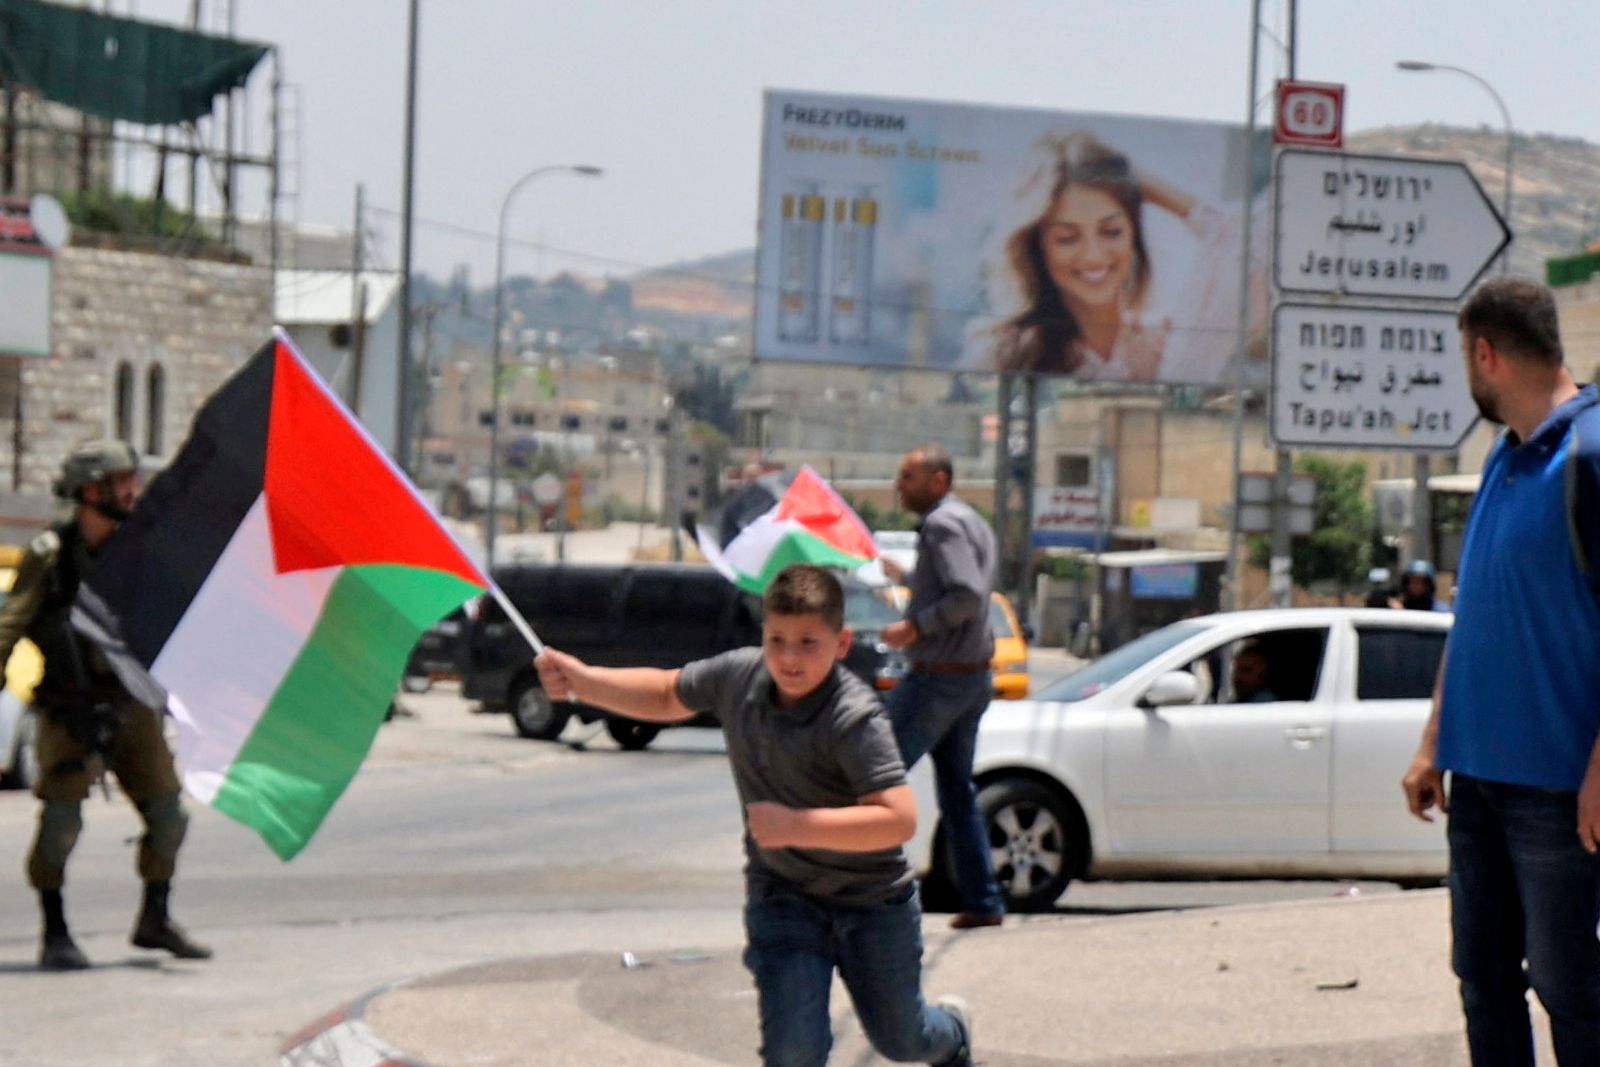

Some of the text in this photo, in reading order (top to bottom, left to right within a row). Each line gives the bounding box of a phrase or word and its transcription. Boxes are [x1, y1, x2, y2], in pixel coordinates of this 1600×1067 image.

[1292, 102, 1328, 127] 60
[786, 133, 980, 163] Velvet Sun Screen
[1323, 170, 1433, 202] ירושלים
[1300, 250, 1449, 281] Jerusalem
[1300, 323, 1446, 353] צומת תפוח
[1291, 401, 1453, 434] Tapu'ah Jct
